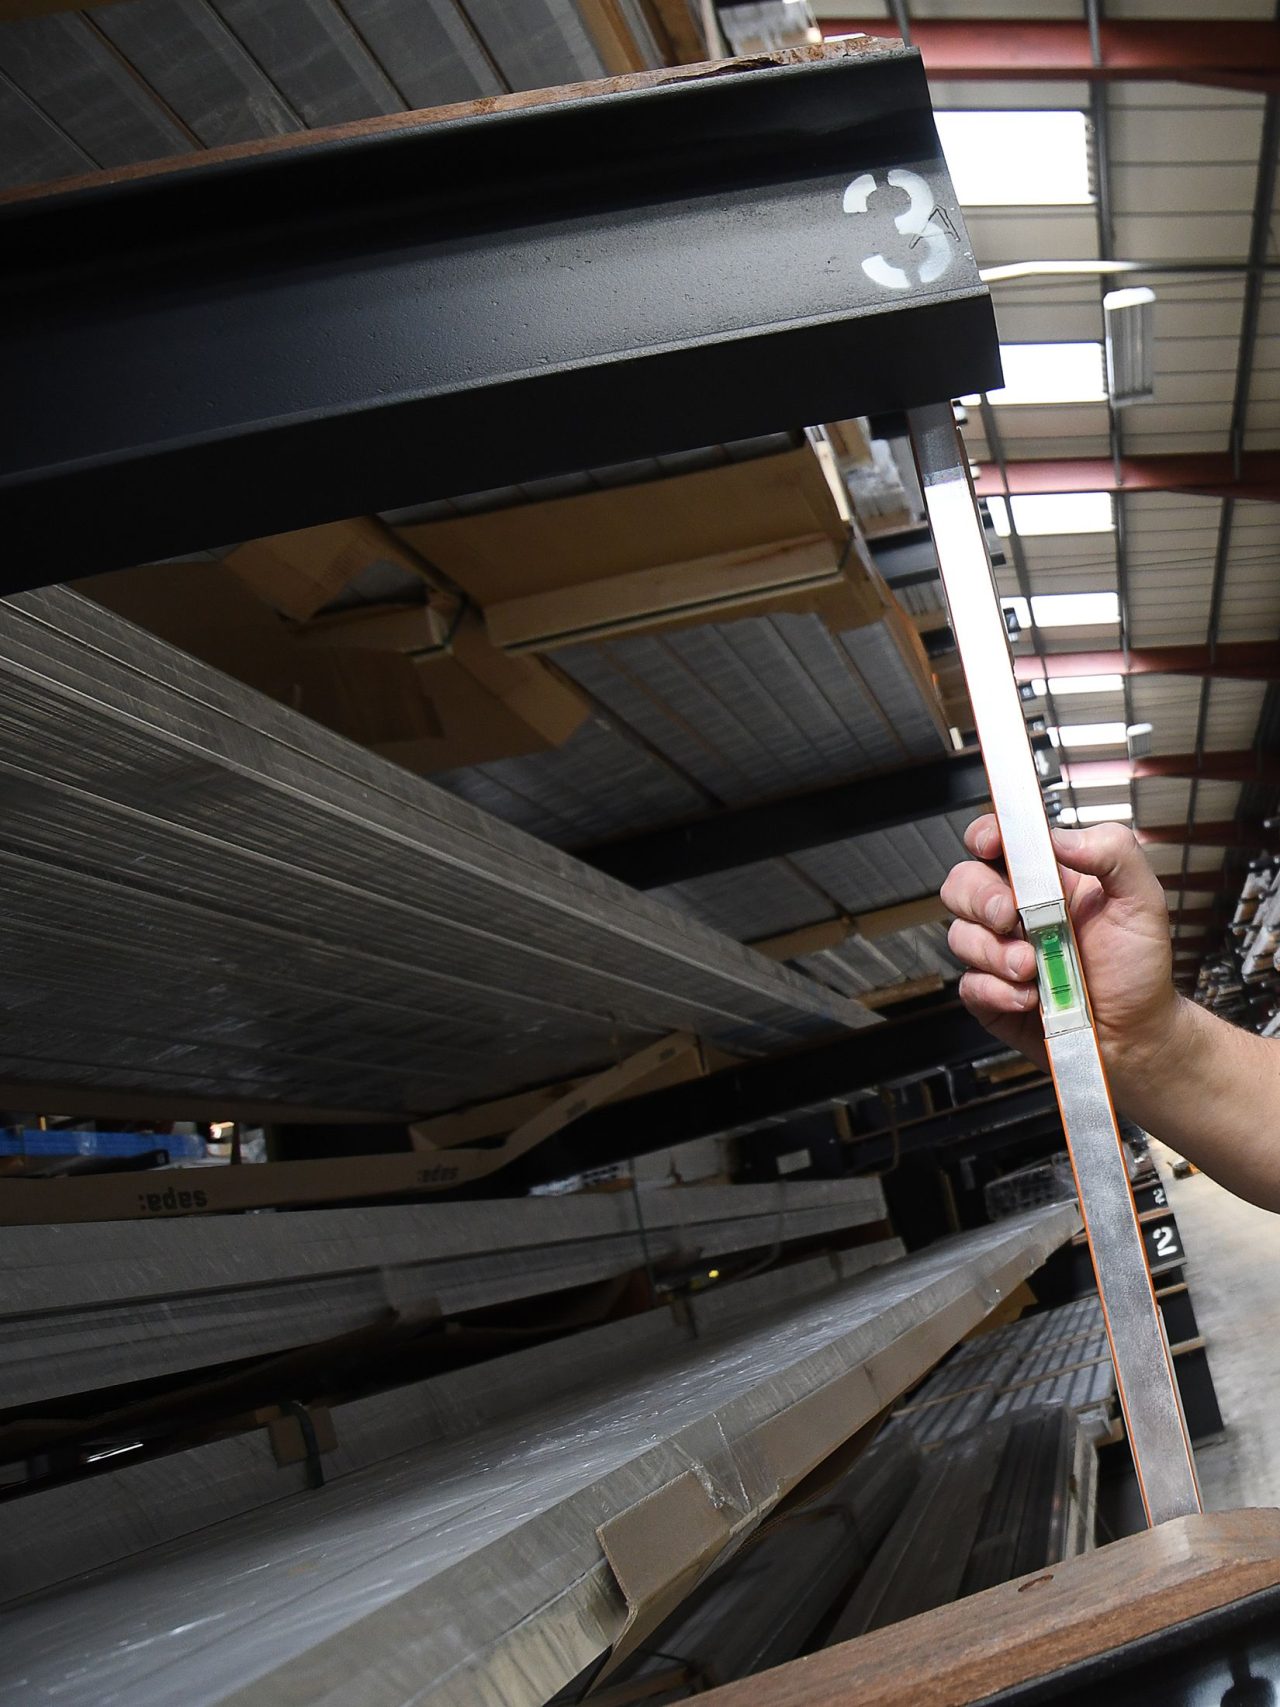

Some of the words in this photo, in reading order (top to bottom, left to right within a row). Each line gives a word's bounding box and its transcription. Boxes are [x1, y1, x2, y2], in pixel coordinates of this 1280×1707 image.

[843, 168, 952, 289] 3
[1152, 1188, 1166, 1205] 2
[1152, 1226, 1178, 1257] 2
